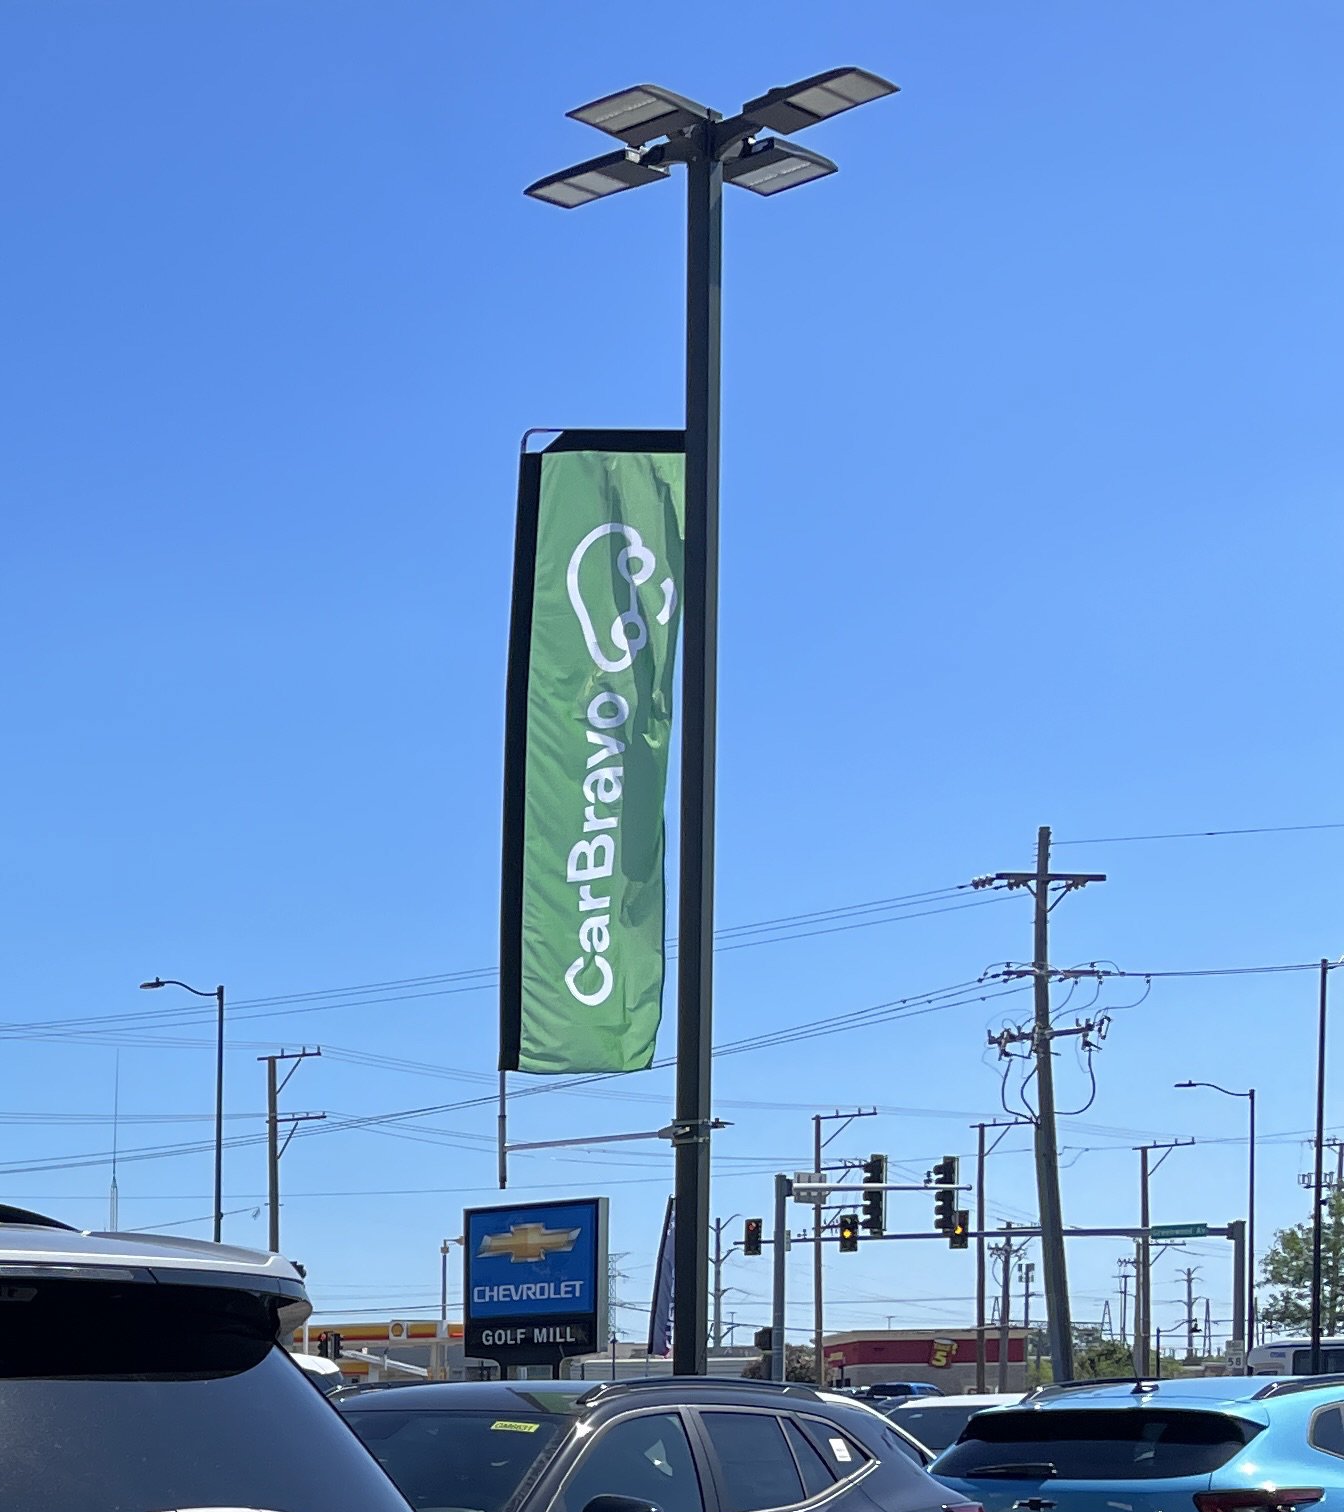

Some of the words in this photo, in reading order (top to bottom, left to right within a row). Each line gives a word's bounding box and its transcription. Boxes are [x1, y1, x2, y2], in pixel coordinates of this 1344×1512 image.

[565, 690, 630, 1007] CarBravo
[473, 1280, 585, 1303] CHEVROLET
[482, 1328, 527, 1346] GOLF
[533, 1326, 576, 1344] MILL
